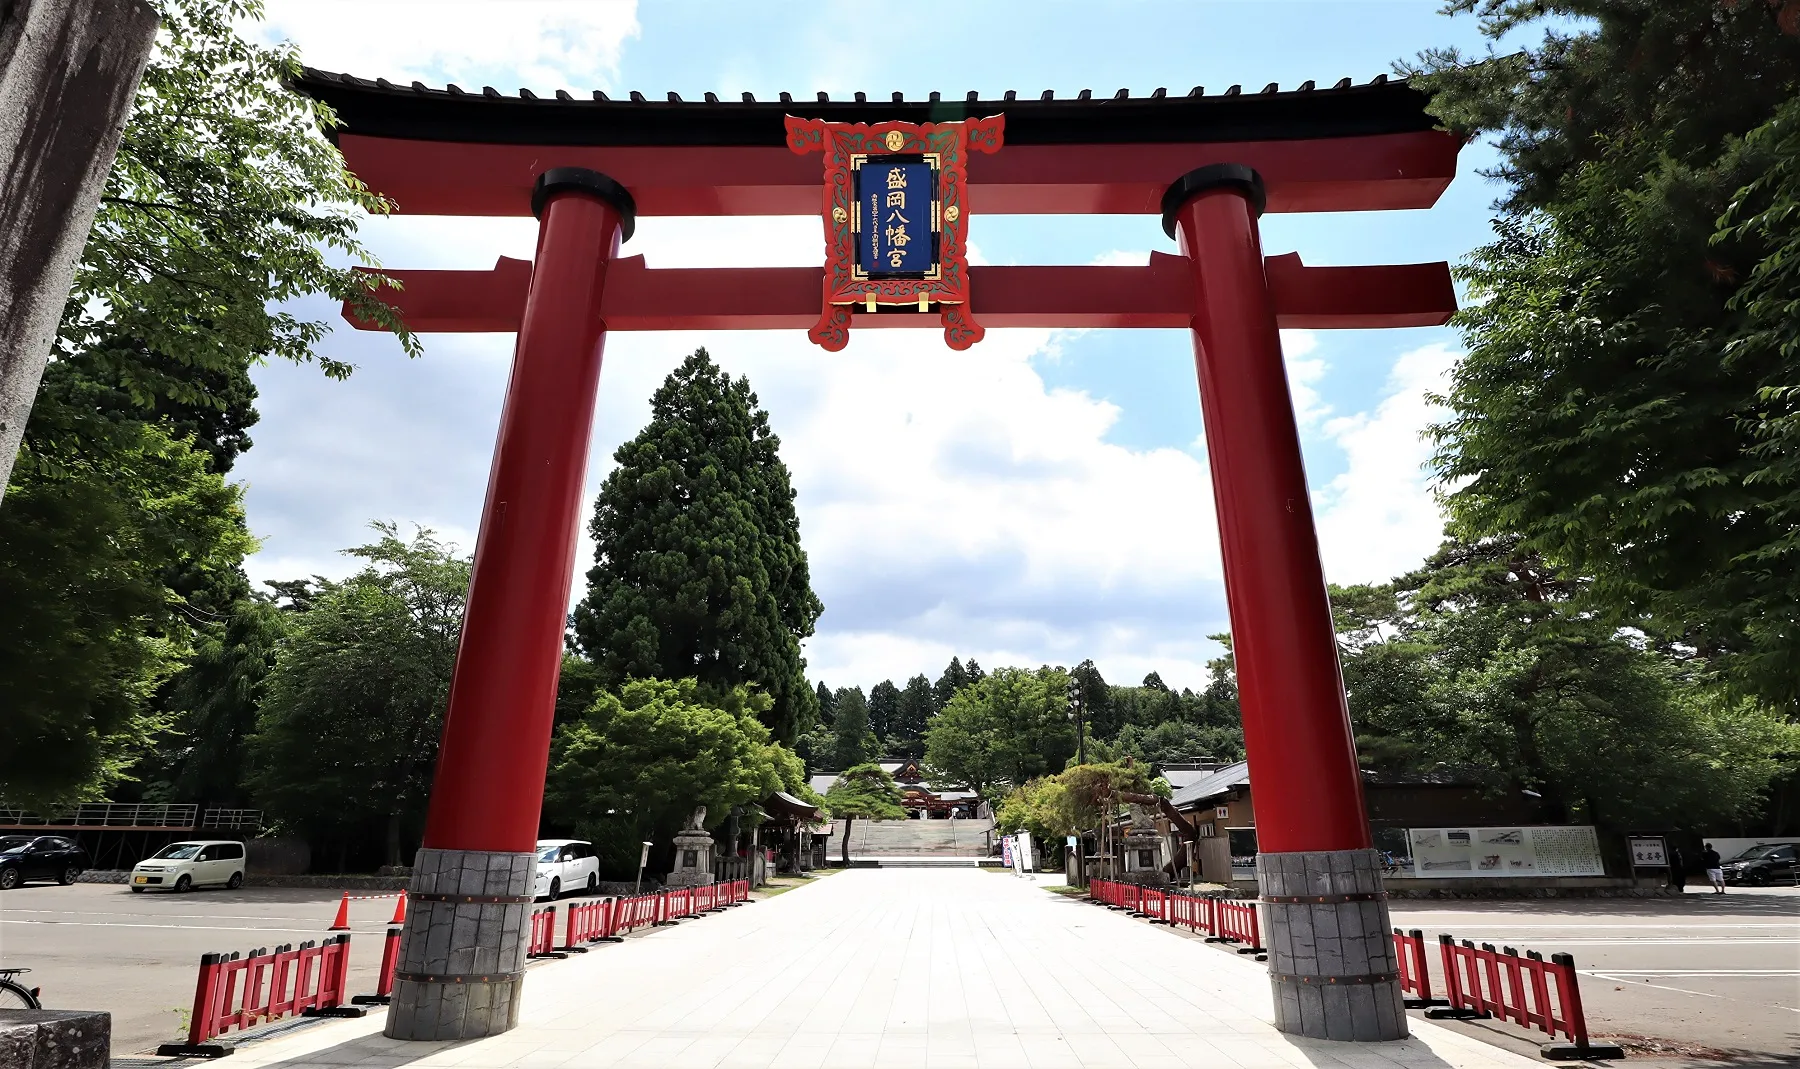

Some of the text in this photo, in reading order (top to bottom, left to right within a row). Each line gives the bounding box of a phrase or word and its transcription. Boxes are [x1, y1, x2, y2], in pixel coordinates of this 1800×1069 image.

[885, 167, 911, 268] 盛岡八幡宮
